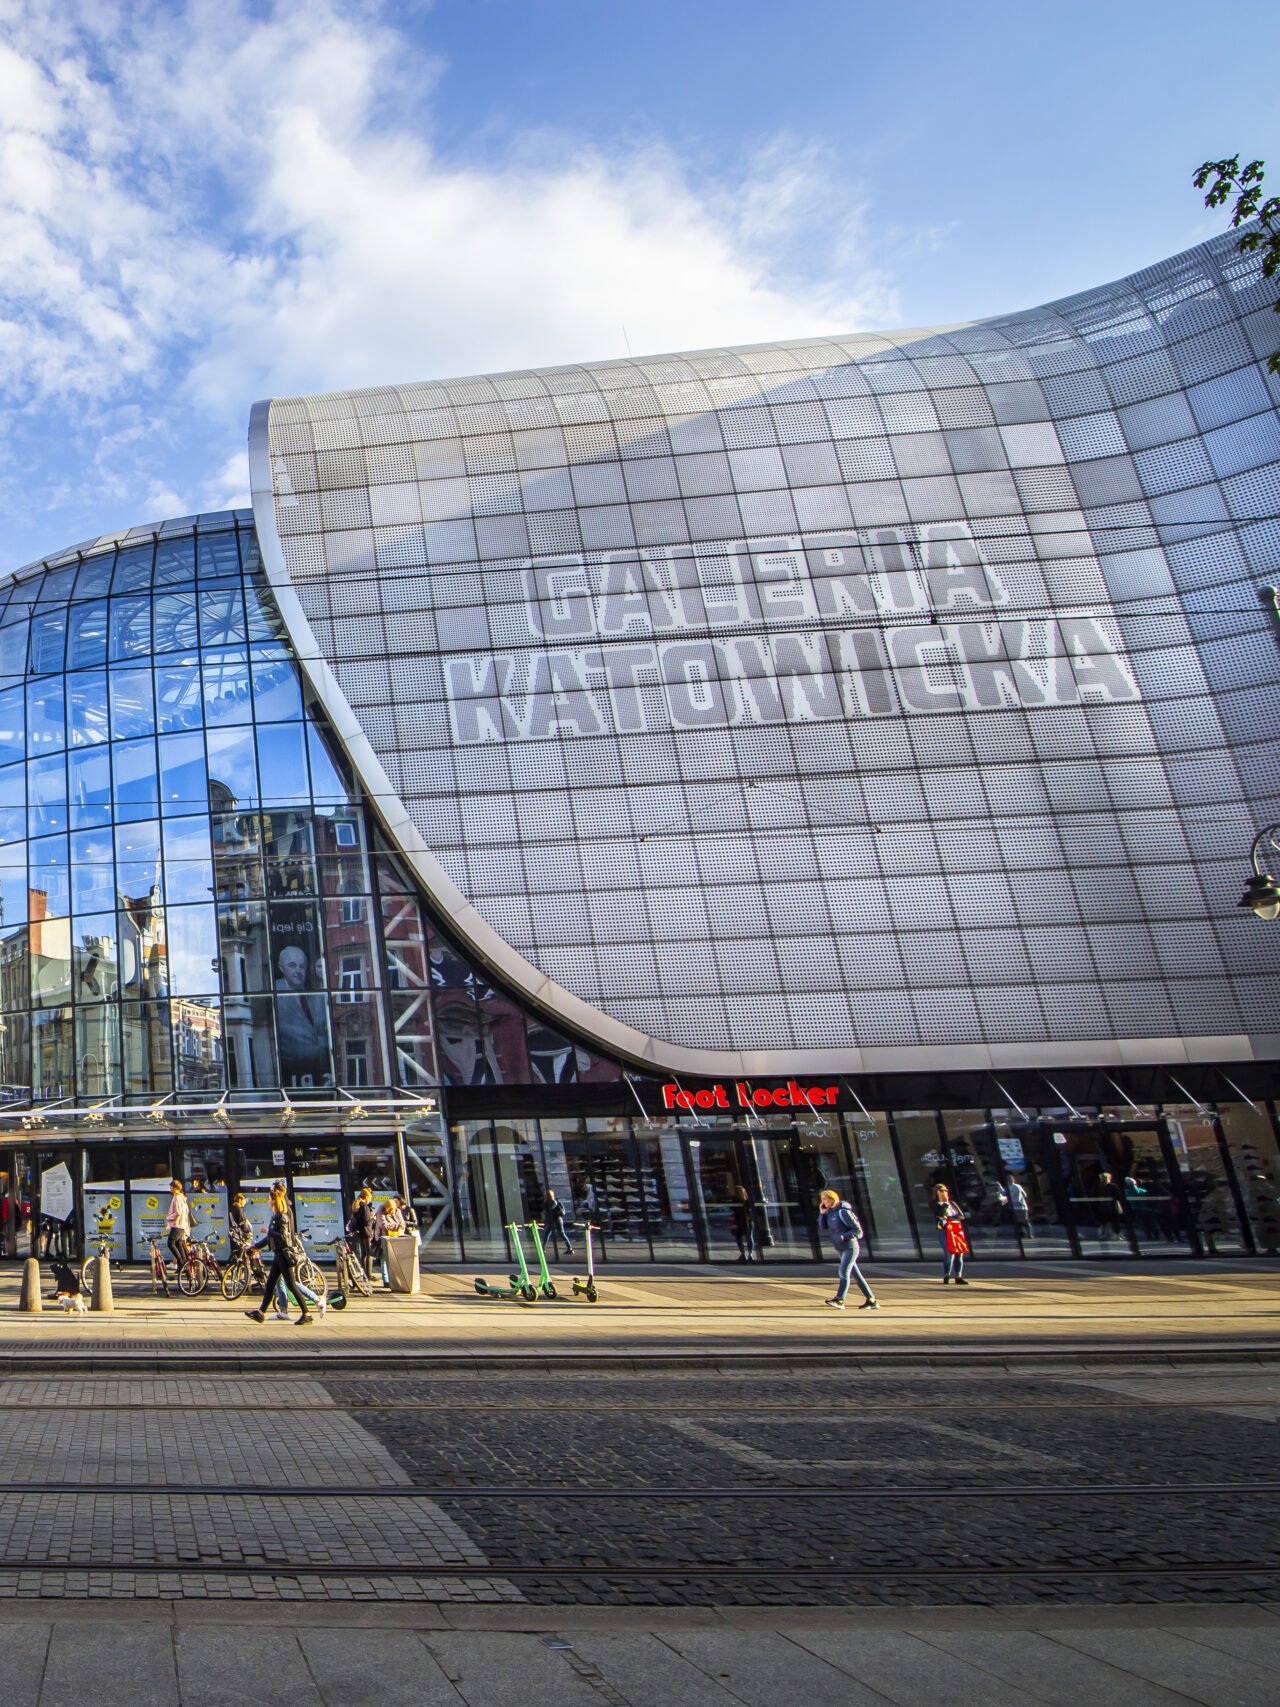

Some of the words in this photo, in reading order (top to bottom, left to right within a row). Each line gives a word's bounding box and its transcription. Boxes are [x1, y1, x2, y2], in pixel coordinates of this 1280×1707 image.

[527, 522, 1007, 640] GALERIA
[445, 616, 1141, 742] KATOWICKA
[662, 1083, 729, 1109] Foot
[736, 1080, 839, 1108] Locker
